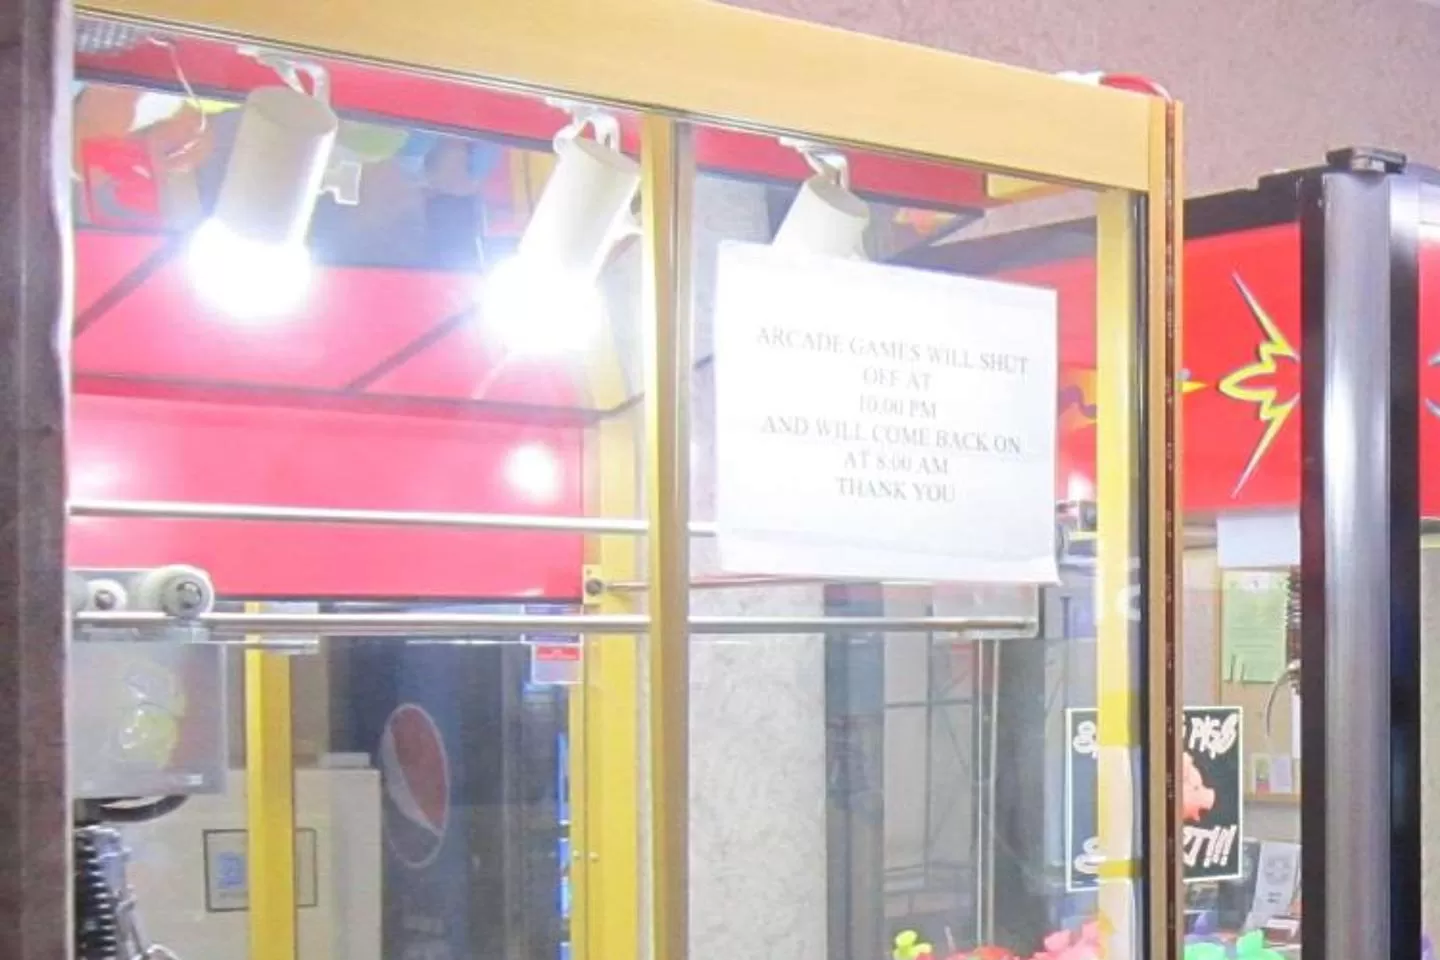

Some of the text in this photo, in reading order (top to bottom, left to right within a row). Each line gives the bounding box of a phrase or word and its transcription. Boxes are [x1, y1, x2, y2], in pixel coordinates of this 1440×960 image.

[756, 325, 1030, 375] ARCADE GAMES WILL SHUT
[863, 365, 932, 391] OFF AT
[909, 399, 937, 419] PM
[760, 415, 1021, 454] AND WILL COME BACK ON
[844, 450, 870, 469] AT
[915, 456, 949, 475] AM
[835, 476, 956, 502] THANK YOU
